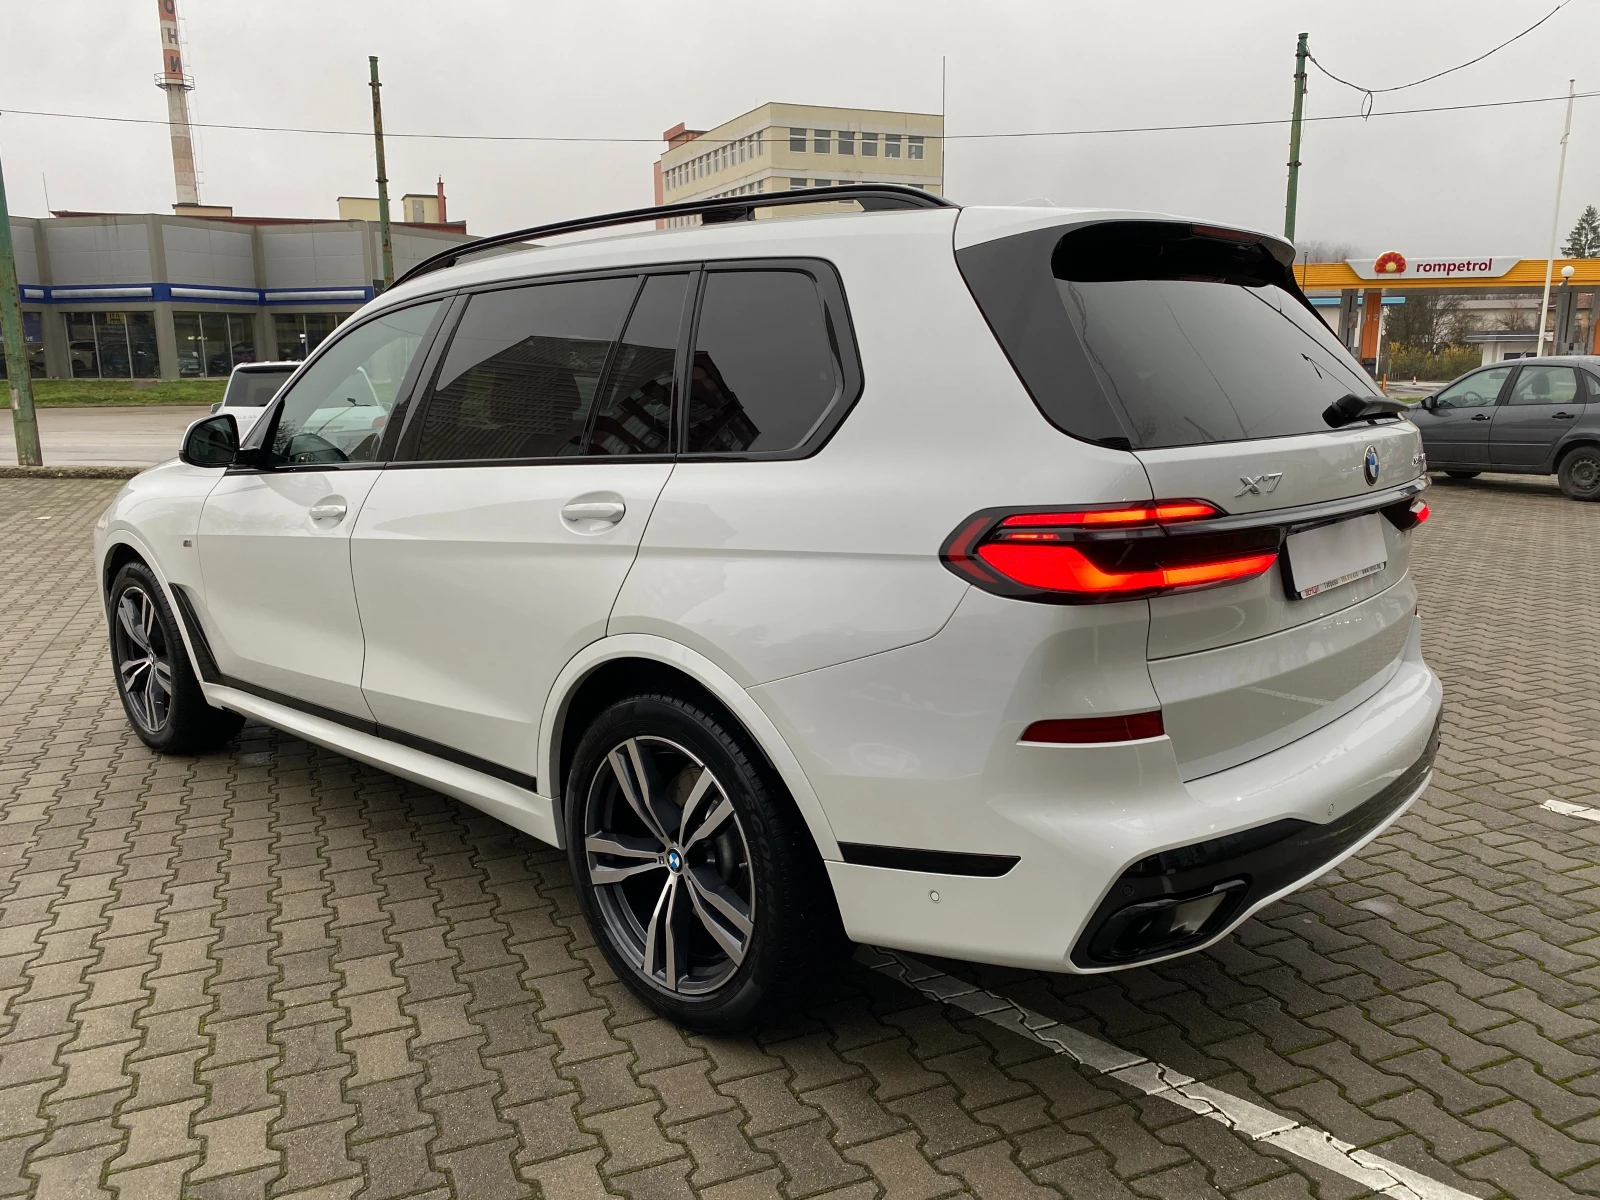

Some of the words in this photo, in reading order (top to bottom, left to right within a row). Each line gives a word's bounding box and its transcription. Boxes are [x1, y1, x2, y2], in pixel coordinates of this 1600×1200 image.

[1416, 257, 1493, 276] rompetrol
[1373, 313, 1379, 321] 2
[1234, 472, 1283, 498] X7
